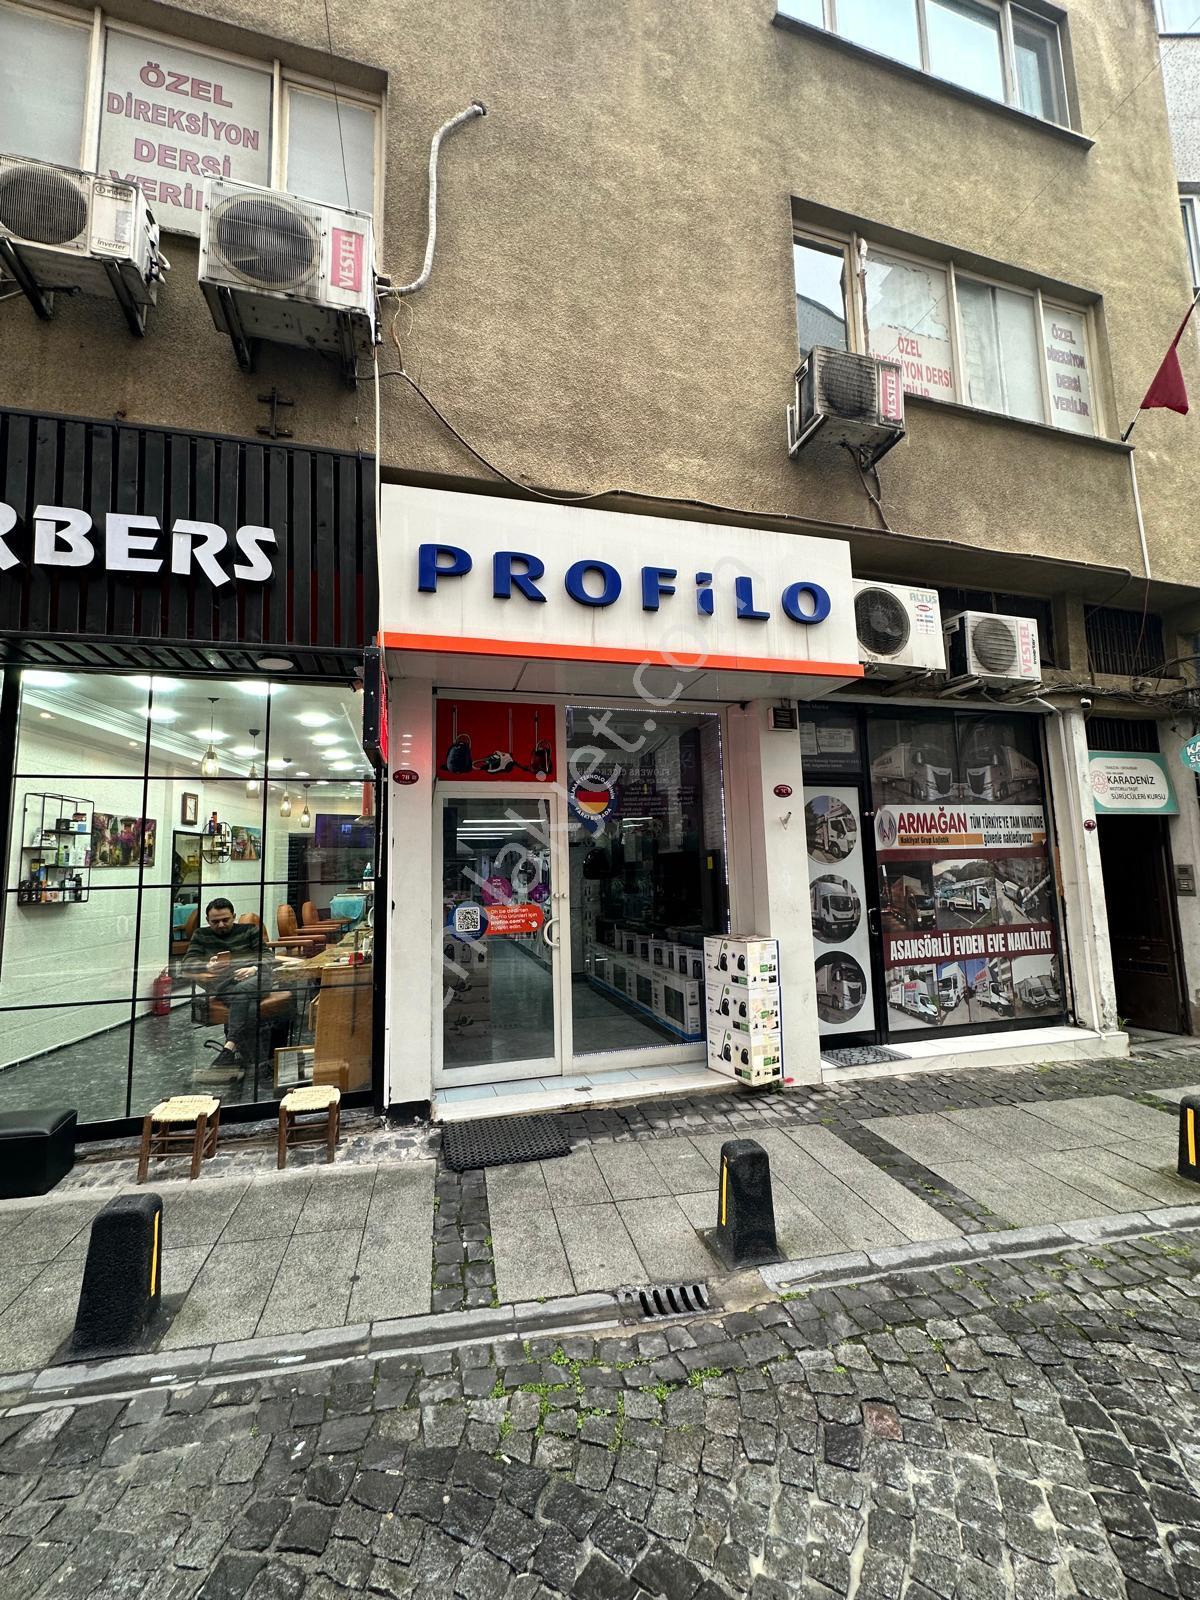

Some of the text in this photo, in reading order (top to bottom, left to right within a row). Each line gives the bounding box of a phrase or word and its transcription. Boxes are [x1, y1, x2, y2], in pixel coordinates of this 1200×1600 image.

[139, 61, 233, 108] ÖZEL
[106, 92, 260, 152] DİREKSİYON
[133, 137, 232, 178] DERSİ
[338, 233, 357, 288] VESTEL
[897, 332, 922, 358] ÖZEL
[1051, 322, 1076, 345] ÖZEL
[925, 366, 953, 389] DERSİ
[1055, 372, 1082, 393] DERSİ
[1053, 395, 1089, 417] VERİLİR
[909, 592, 938, 604] ALTUS
[1020, 623, 1033, 674] VESTEL
[1106, 774, 1156, 785] KARADENİZ
[1147, 793, 1166, 801] KURSU
[898, 806, 968, 834] ARMAĞAN
[970, 813, 981, 829] TÜM
[1009, 815, 1020, 829] TAM
[1021, 813, 1044, 829] VAKTİNDE
[984, 832, 1002, 846] güvenle
[890, 927, 1052, 961] ASANSÖRLÜ EVDEN EVE NAKLİYAT
